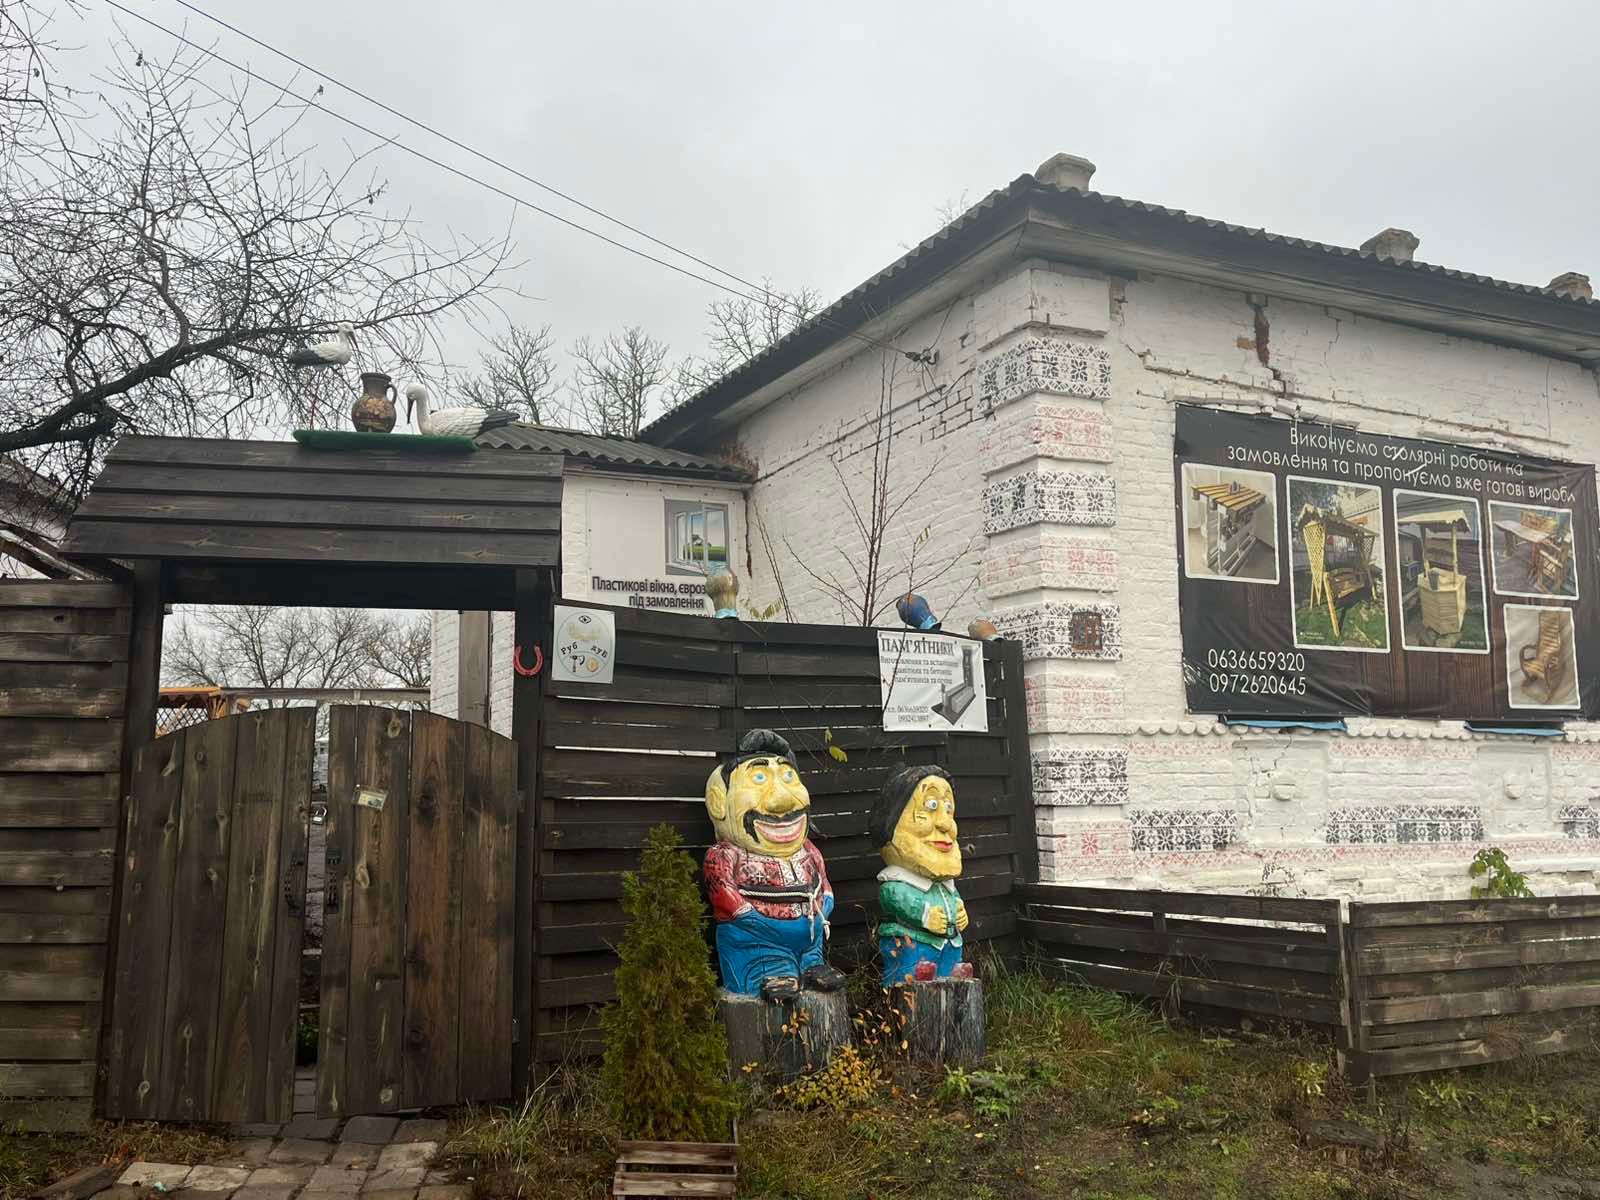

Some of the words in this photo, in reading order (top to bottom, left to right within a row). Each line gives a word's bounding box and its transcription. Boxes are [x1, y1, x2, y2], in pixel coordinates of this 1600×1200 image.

[1290, 427, 1378, 458] Виконуємо
[1383, 444, 1447, 467] столярні
[1450, 452, 1502, 473] роботи
[1505, 463, 1524, 477] на
[1227, 445, 1328, 472] замовлення
[1332, 459, 1349, 474] та
[1354, 462, 1451, 488] пропонуємо
[1455, 477, 1482, 492] вже
[1486, 480, 1525, 497] готові
[592, 576, 648, 593] Пластикові
[650, 579, 678, 595] вікна,
[628, 593, 645, 609] під
[646, 596, 705, 609] замовлення
[1208, 648, 1305, 672] 0636659320
[1209, 673, 1306, 695] 0972620645
